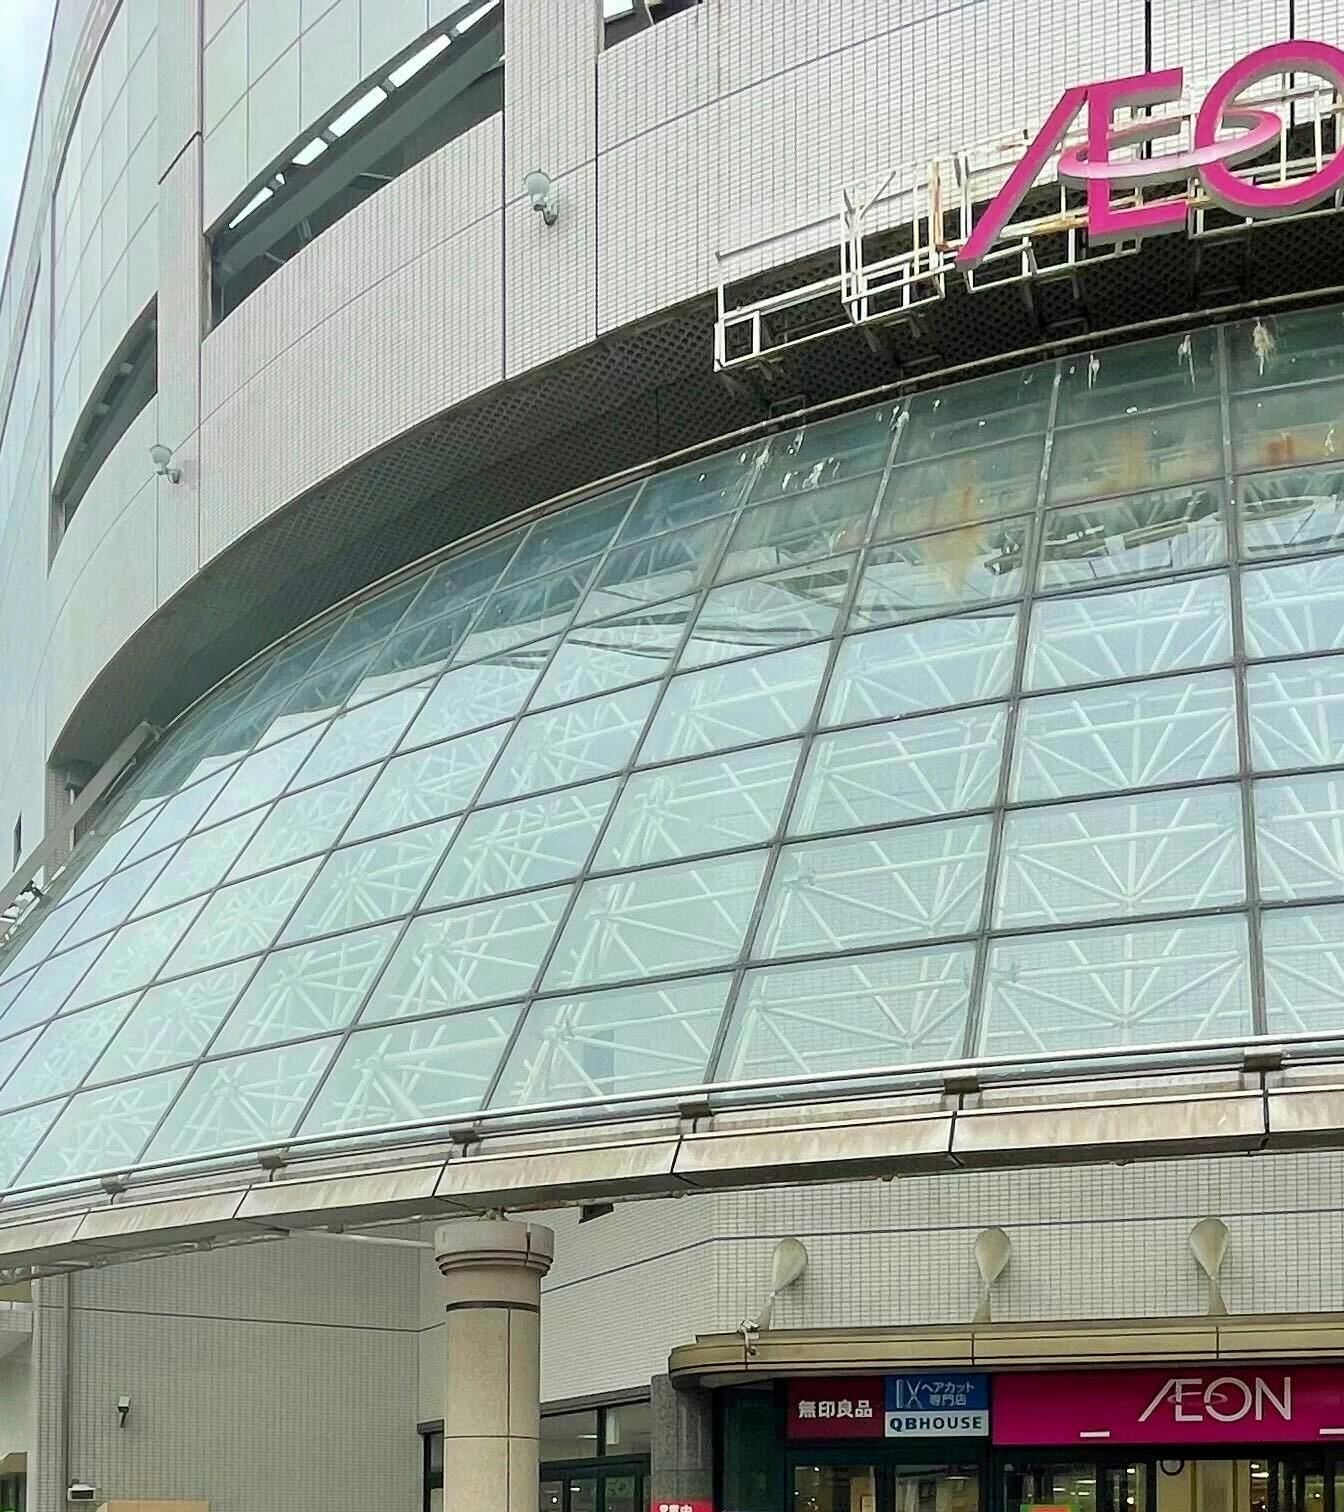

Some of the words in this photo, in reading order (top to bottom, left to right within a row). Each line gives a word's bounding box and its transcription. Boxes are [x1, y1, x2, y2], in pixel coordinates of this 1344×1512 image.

[922, 1382, 974, 1393] ヘアカット
[929, 1395, 967, 1407] 専門店
[798, 1400, 873, 1418] 無印良品
